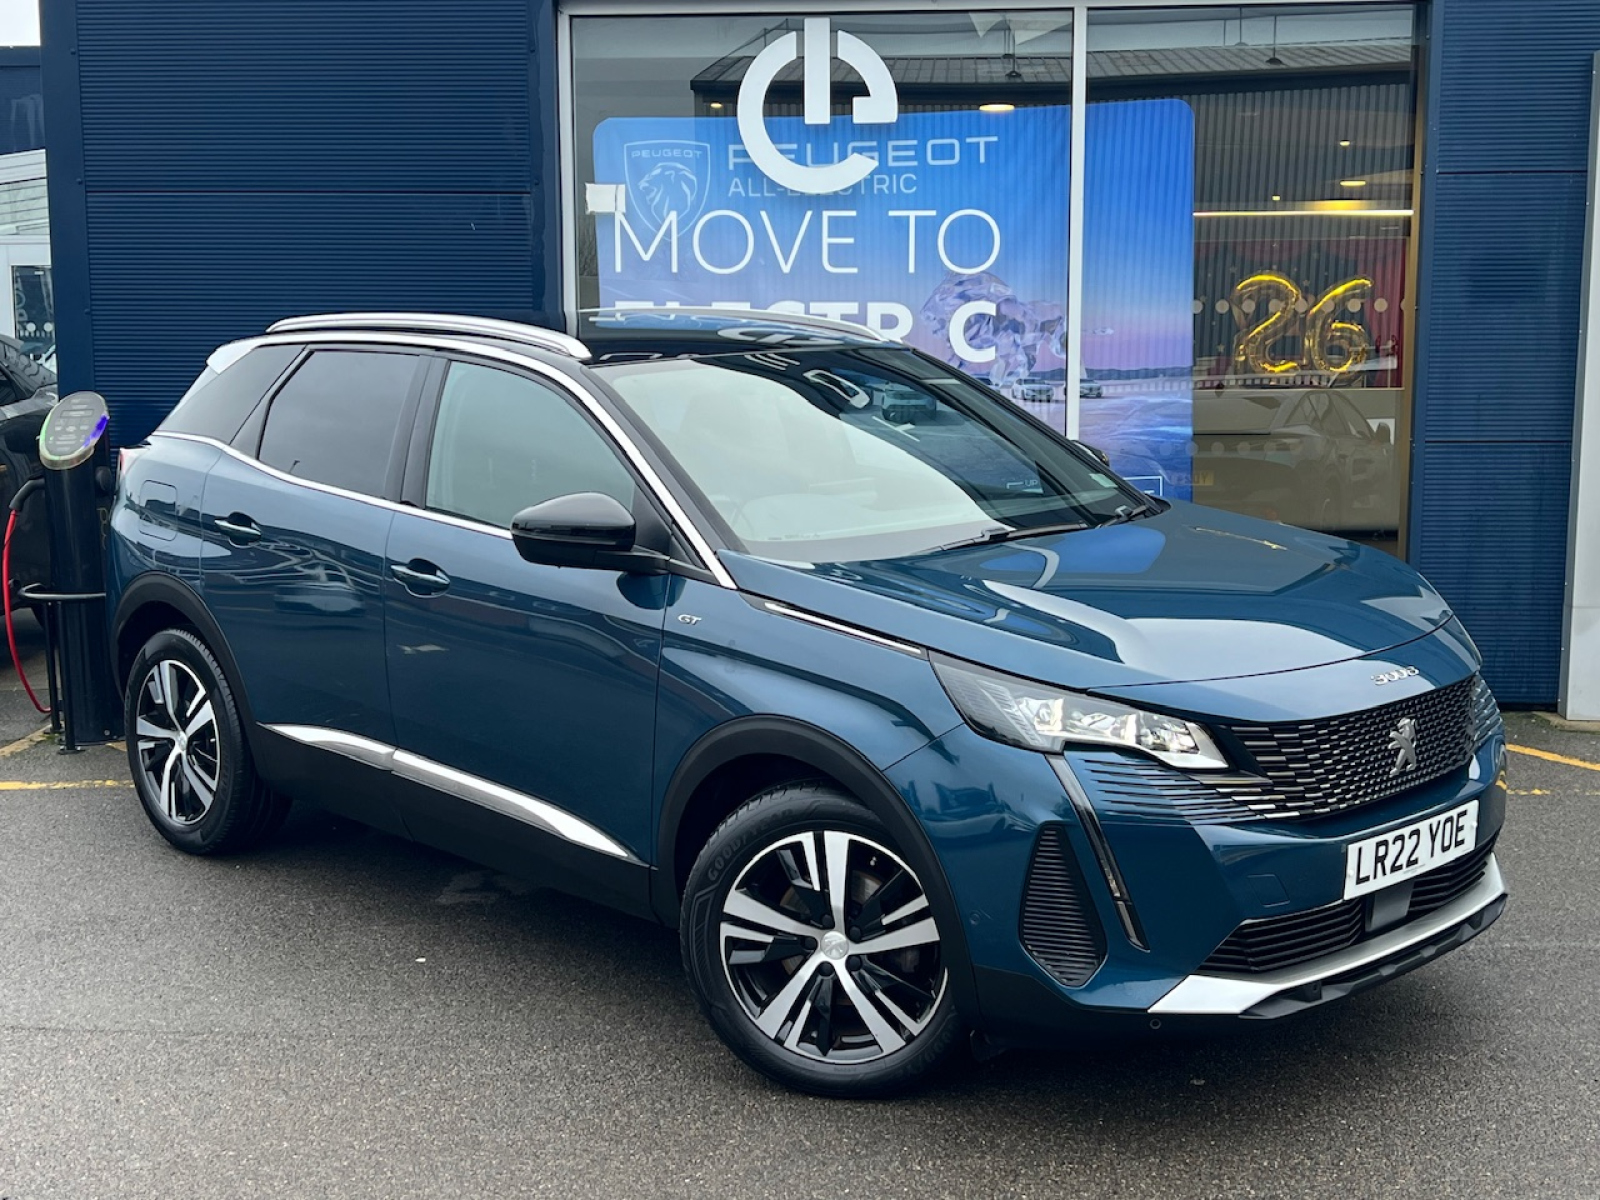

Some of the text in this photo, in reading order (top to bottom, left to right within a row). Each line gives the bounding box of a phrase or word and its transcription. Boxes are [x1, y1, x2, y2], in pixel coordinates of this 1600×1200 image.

[631, 149, 703, 160] PEUGEOT
[614, 208, 1001, 275] MOVE TO
[677, 614, 702, 626] GT
[1371, 665, 1420, 686] 3008
[1356, 809, 1468, 885] LR22 YOE
